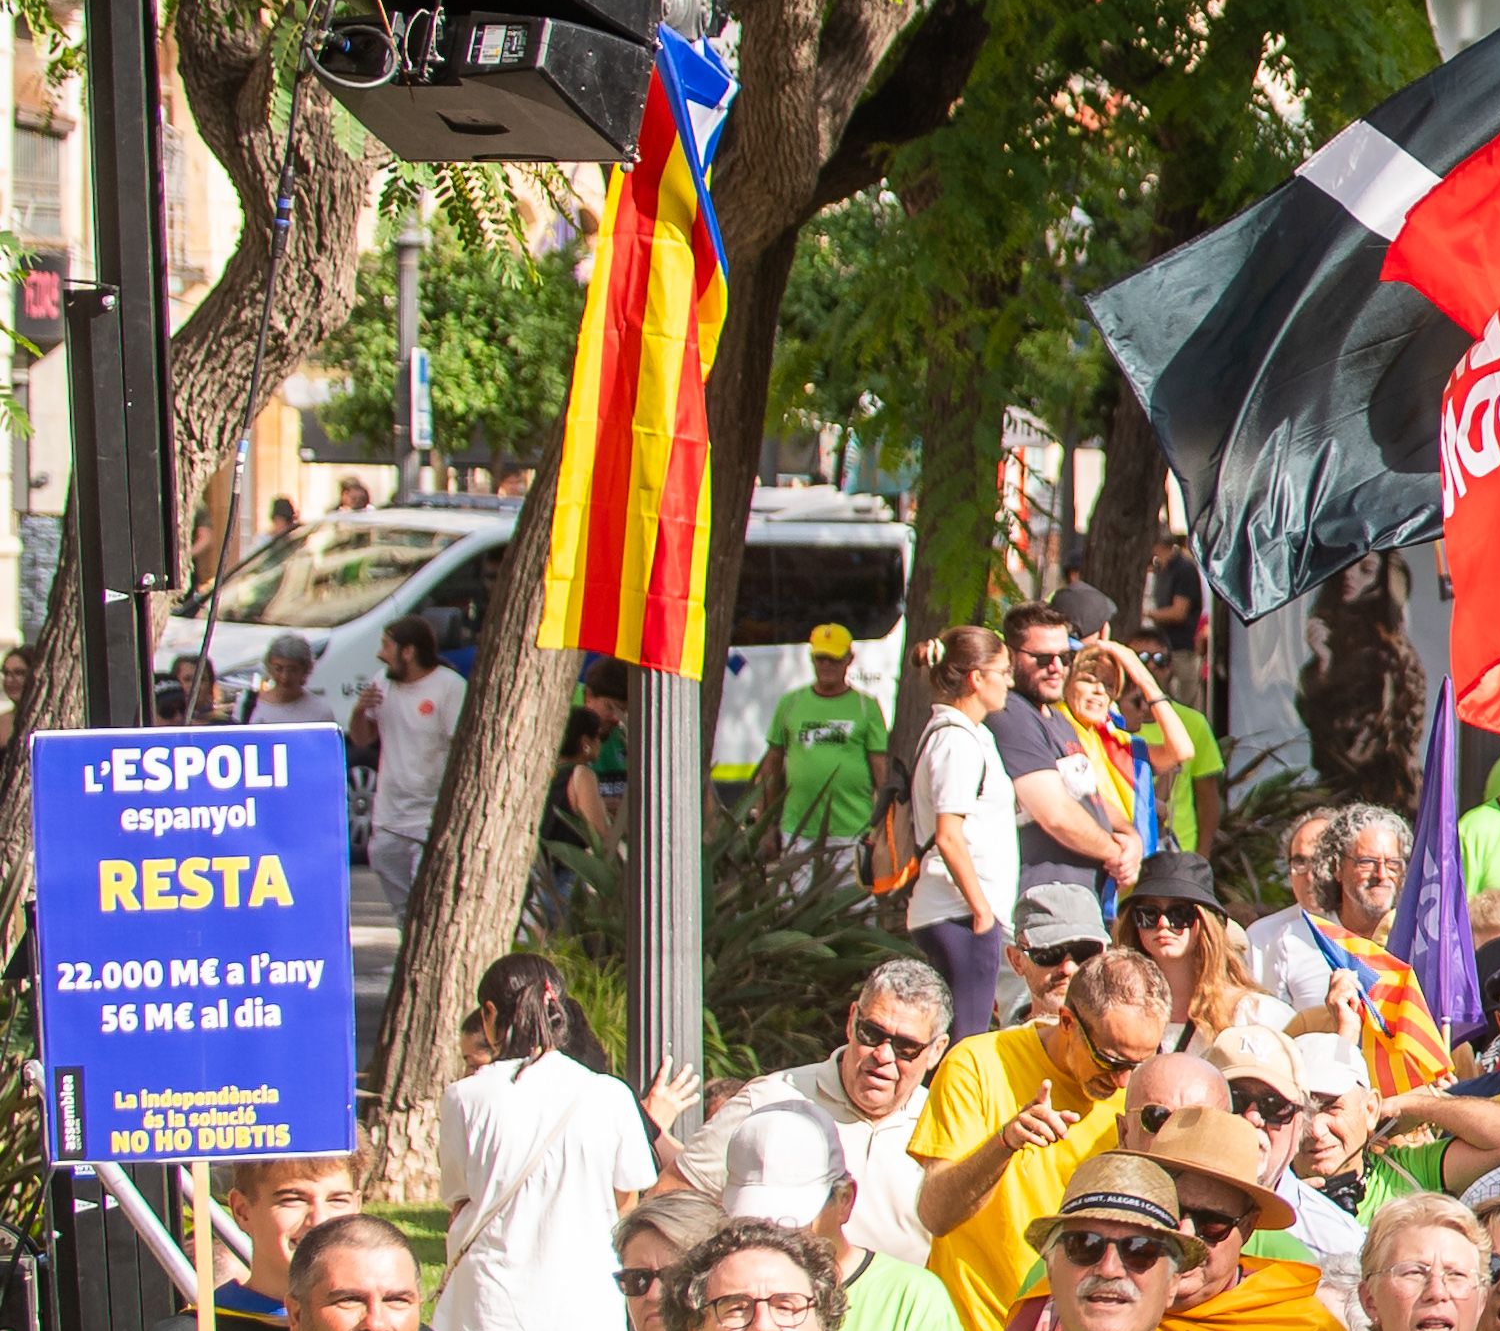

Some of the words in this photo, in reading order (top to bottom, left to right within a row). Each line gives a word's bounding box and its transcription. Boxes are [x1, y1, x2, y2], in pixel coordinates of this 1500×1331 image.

[84, 744, 288, 793] L'ESPOLI
[121, 797, 256, 837] espanyol
[100, 855, 294, 912] RESTA
[57, 960, 163, 990] 22.000
[170, 958, 220, 987] M€
[226, 962, 245, 985] a
[251, 953, 324, 989] l'any
[101, 1003, 138, 1032] 56
[145, 1001, 194, 1030] M€
[201, 999, 229, 1029] al
[234, 997, 282, 1027] dia
[60, 1074, 75, 1151] assemblea
[114, 1090, 138, 1110] La
[140, 1084, 280, 1111] independència
[143, 1109, 165, 1130] és
[167, 1109, 187, 1128] la
[188, 1105, 257, 1127] solució
[110, 1130, 150, 1154] NO
[154, 1128, 193, 1152] HO
[197, 1123, 292, 1150] DUBTIS
